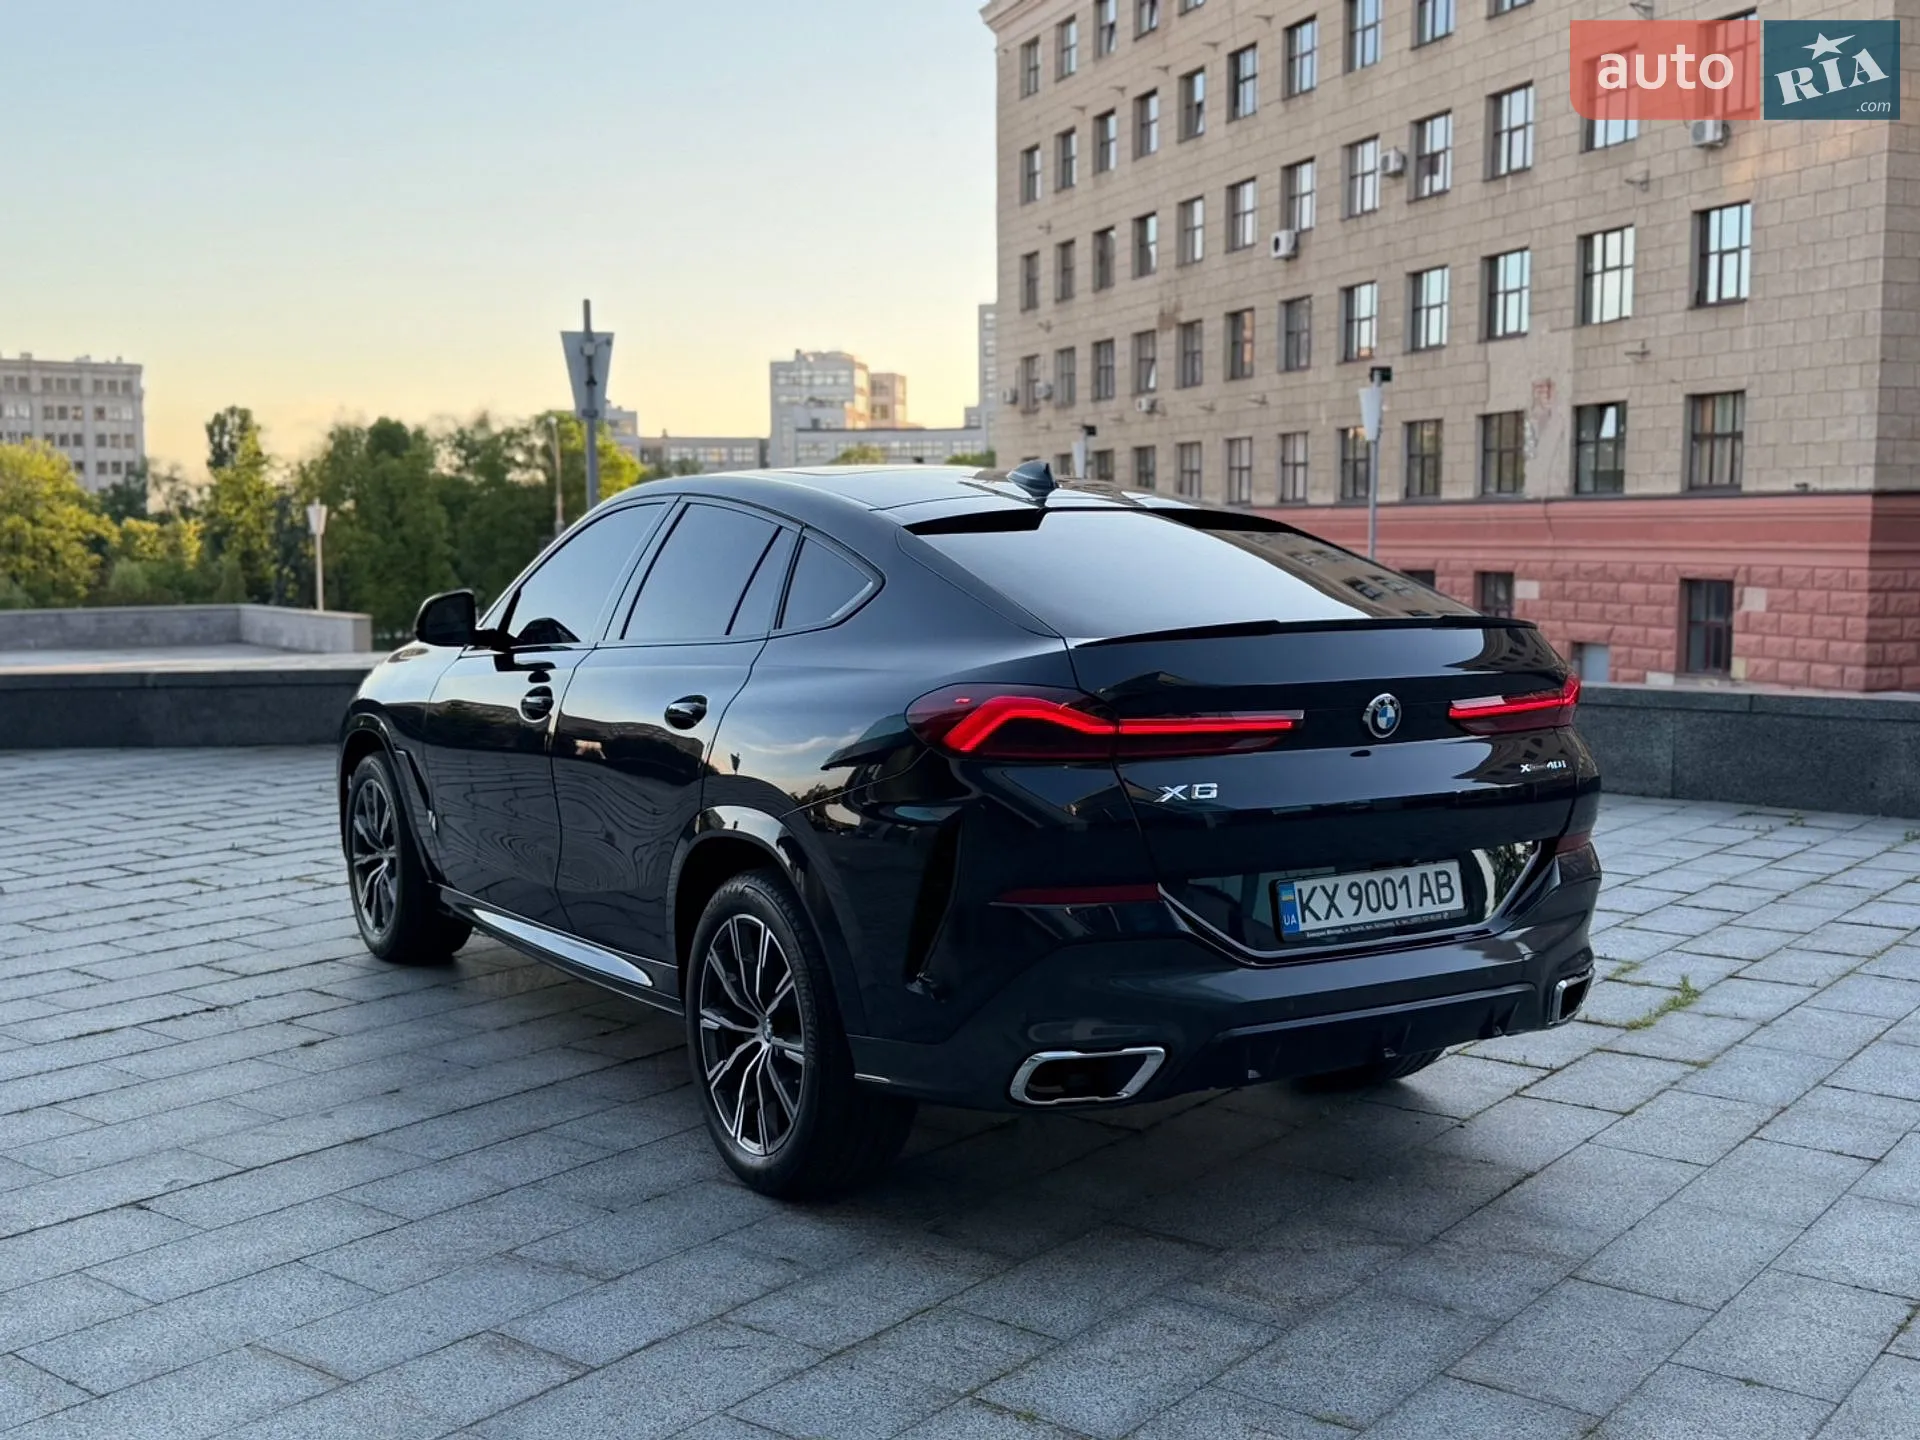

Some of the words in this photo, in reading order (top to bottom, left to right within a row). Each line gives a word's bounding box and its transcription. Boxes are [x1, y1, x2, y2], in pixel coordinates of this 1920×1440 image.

[1153, 783, 1218, 803] X6
[1297, 883, 1344, 924] KX
[1347, 874, 1413, 917] 9001
[1418, 869, 1455, 907] AB
[1283, 915, 1298, 927] UA
